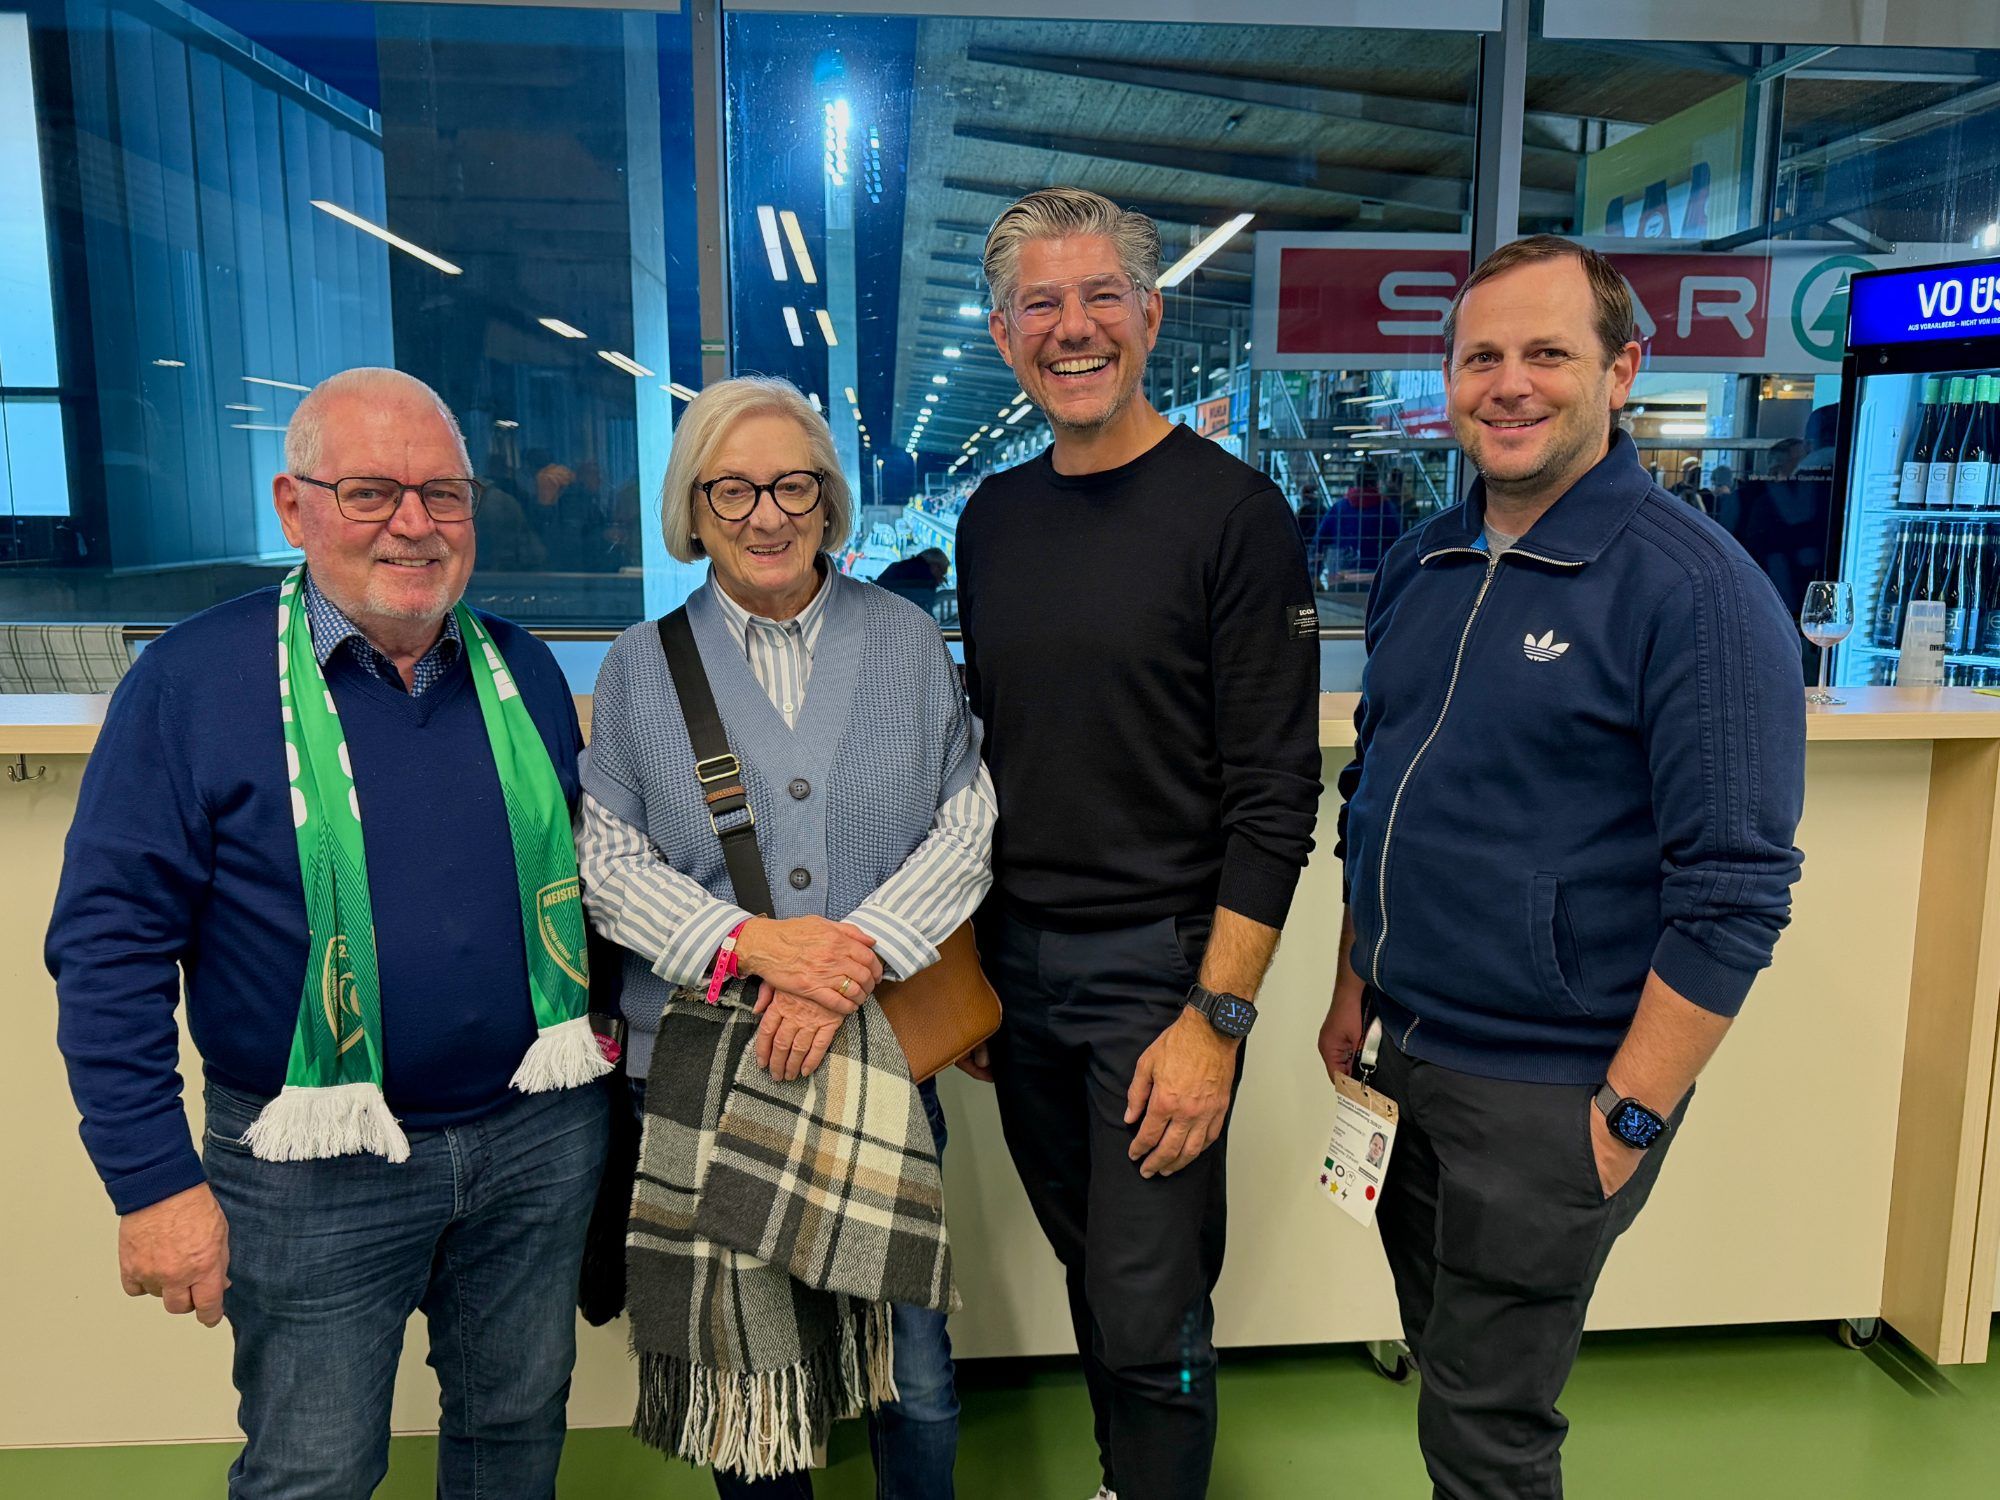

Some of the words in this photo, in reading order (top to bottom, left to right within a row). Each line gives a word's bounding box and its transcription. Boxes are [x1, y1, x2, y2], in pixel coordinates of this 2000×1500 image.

[1918, 280, 1963, 319] VO
[1908, 323, 1919, 331] AUS
[1919, 320, 1956, 331] VORARLBERG
[1960, 319, 1978, 327] NICHT
[1979, 317, 1991, 325] VON
